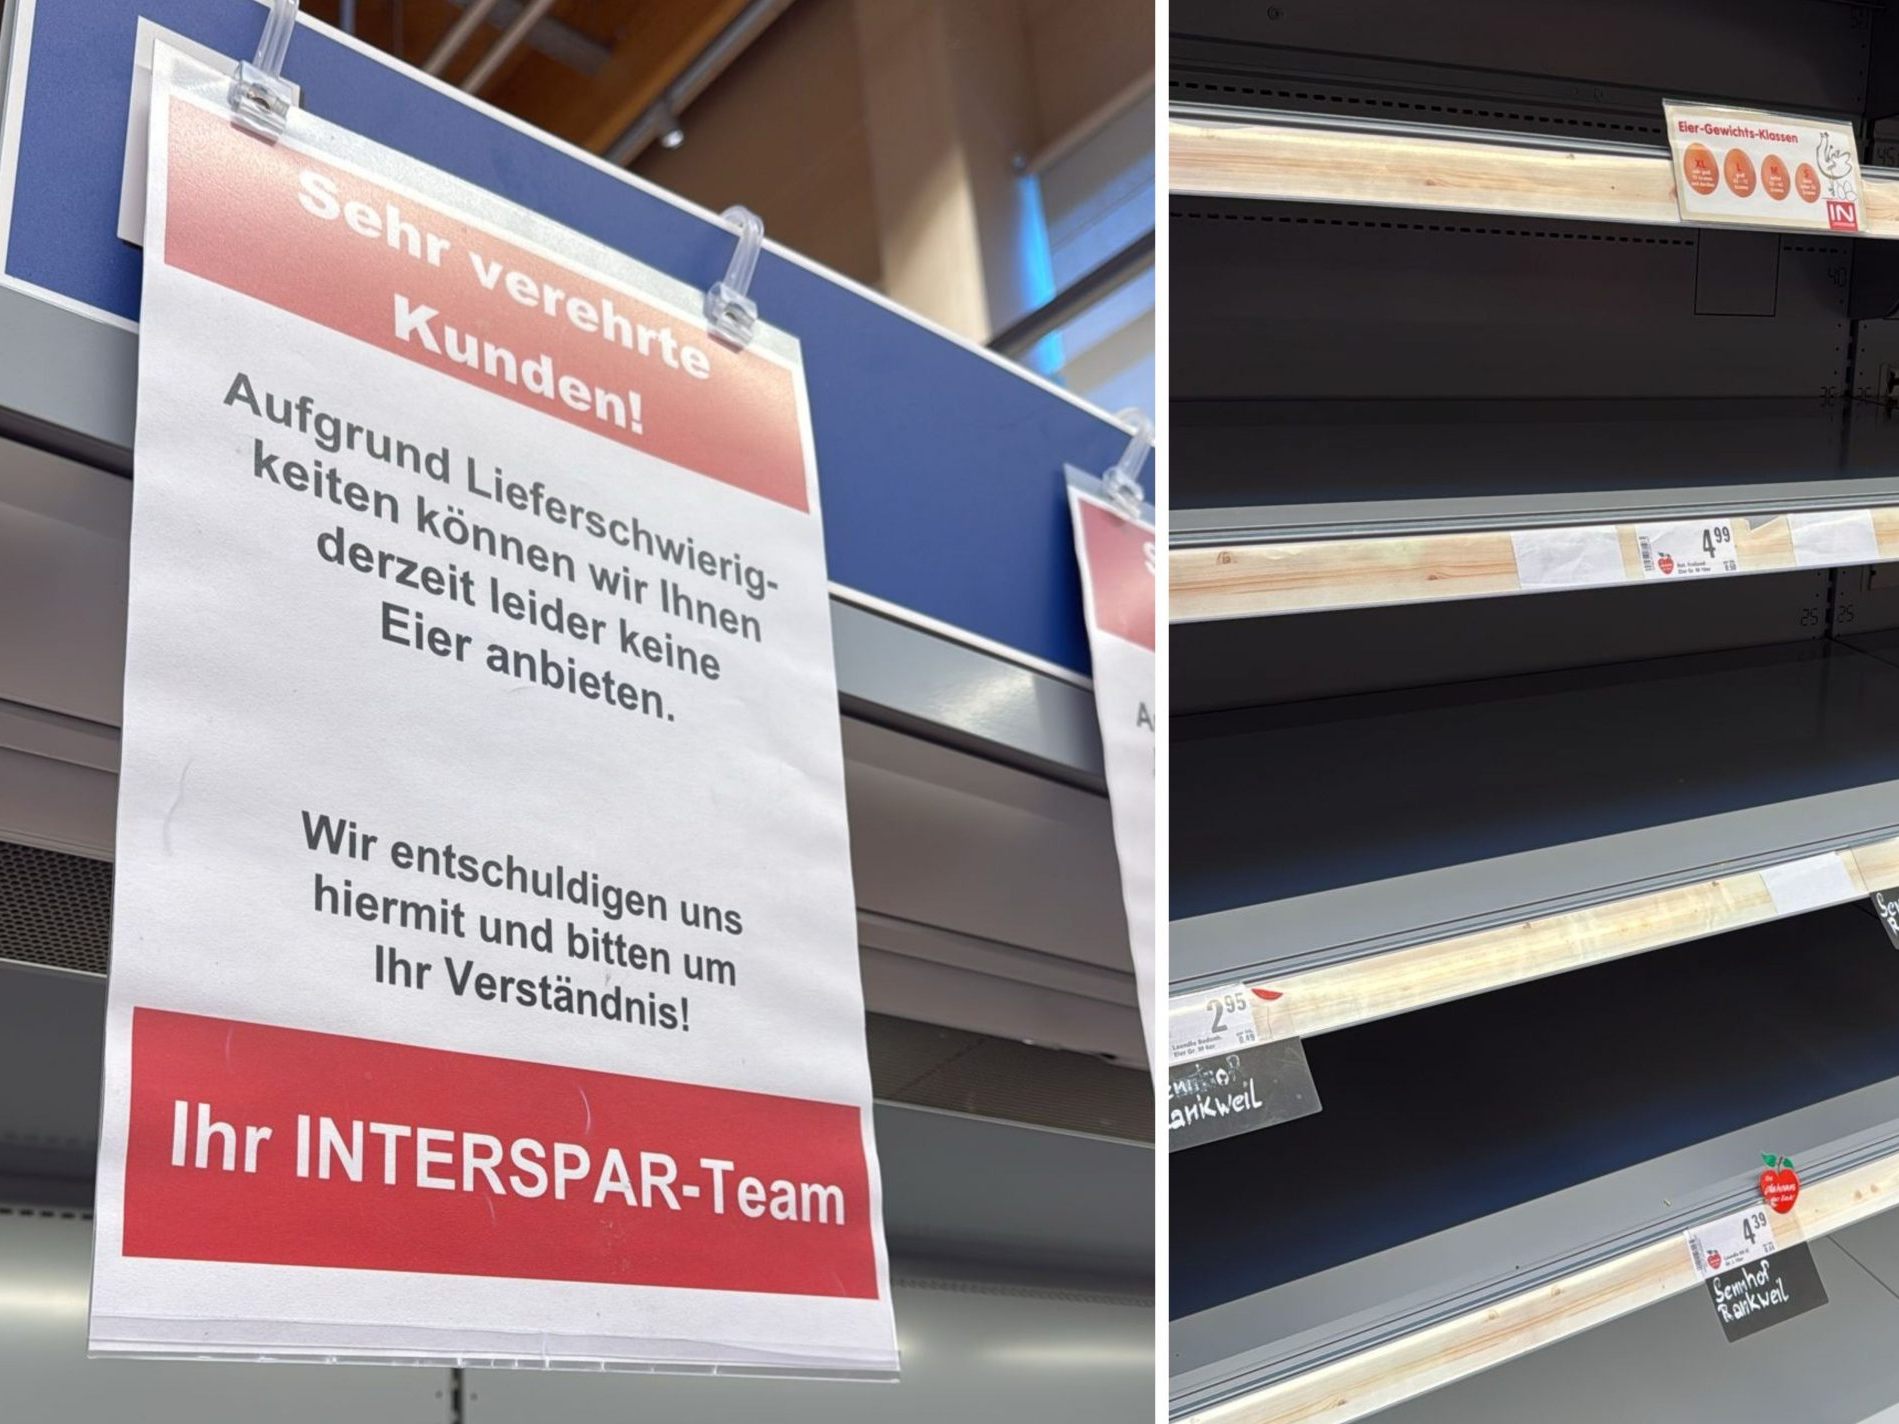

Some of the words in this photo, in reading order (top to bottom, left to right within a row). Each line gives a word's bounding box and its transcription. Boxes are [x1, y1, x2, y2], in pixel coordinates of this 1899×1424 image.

[1678, 121, 1798, 143] Eier-Gewichts-Klassen
[1695, 159, 1706, 169] XL
[1830, 203, 1855, 222] IN
[298, 168, 451, 268] Sehr
[468, 248, 711, 380] verehrte
[393, 293, 644, 435] Kunden!
[223, 371, 451, 485] Aufgrund
[467, 457, 779, 601] Lieferschwierig-
[253, 439, 399, 523] keiten
[416, 494, 576, 582] können
[588, 556, 648, 605] wir
[660, 578, 762, 644] Ihnen
[316, 526, 475, 606] derzeit
[490, 577, 606, 645] leider
[619, 618, 722, 681] keine
[382, 601, 472, 662] Eier
[486, 634, 677, 722] anbieten.
[1136, 702, 1155, 732] A
[301, 810, 377, 862] Wir
[390, 841, 668, 922] entschuldigen
[680, 900, 744, 936] uns
[313, 873, 466, 939] hiermit
[478, 914, 554, 956] und
[567, 922, 671, 975] bitten
[682, 952, 737, 987] um
[375, 945, 432, 992] Ihr
[443, 956, 691, 1033] Verständnis!
[1169, 1078, 1262, 1129] ankweil
[171, 1100, 272, 1174] Ihr
[296, 1113, 846, 1226] INTERSPAR-Team
[1717, 1278, 1789, 1322] Rankweil
